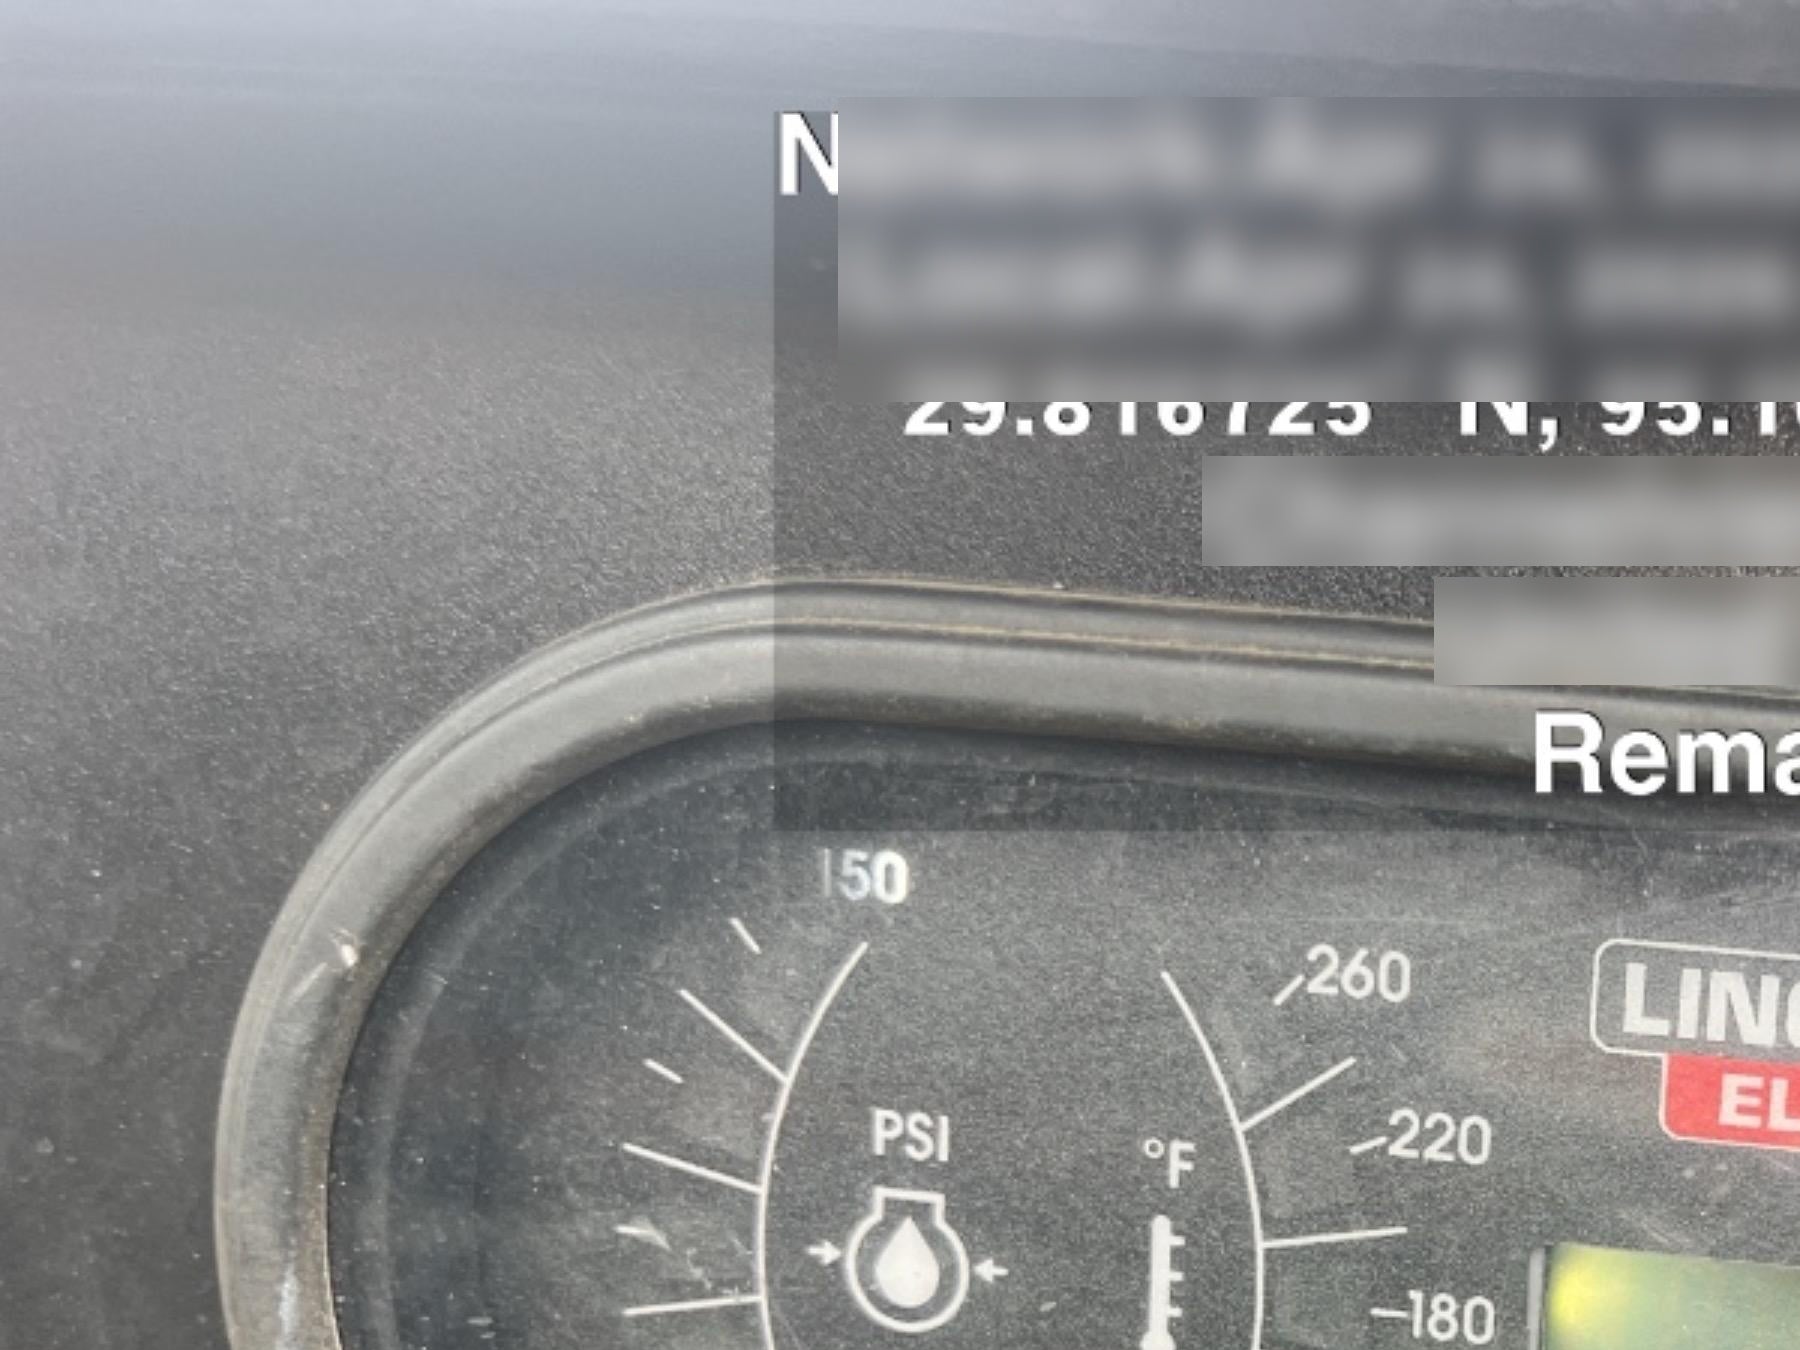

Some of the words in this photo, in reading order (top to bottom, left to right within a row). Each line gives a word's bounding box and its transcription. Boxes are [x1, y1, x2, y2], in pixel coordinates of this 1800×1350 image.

[1305, 945, 1411, 1001] 260
[873, 1110, 949, 1162] PSI
[1387, 1110, 1491, 1165] 220
[1408, 1291, 1495, 1345] 180
